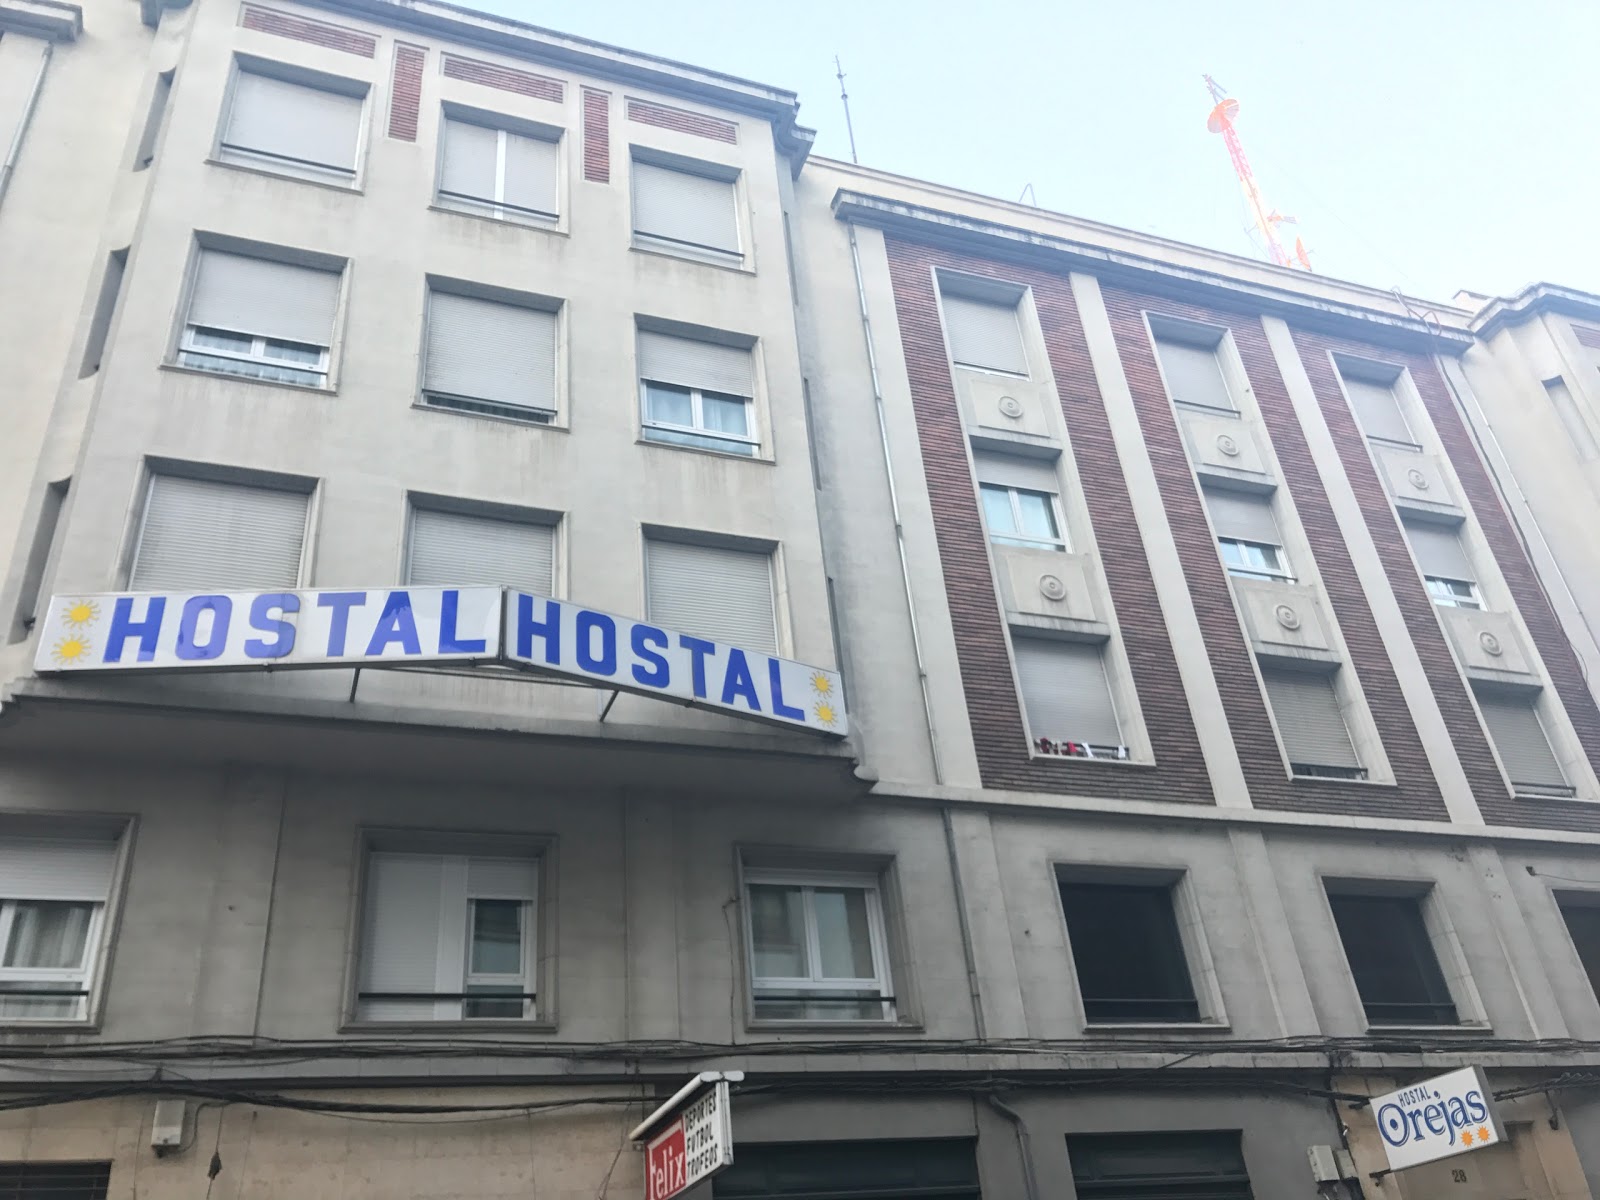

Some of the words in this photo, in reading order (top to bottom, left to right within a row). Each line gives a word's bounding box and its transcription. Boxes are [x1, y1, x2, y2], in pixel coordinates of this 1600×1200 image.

[103, 590, 487, 663] HOSTAL
[517, 594, 806, 721] HOSTAL
[685, 1091, 717, 1133] DEPORTES
[1398, 1085, 1431, 1107] HOSTAL
[1377, 1090, 1488, 1147] Orejas
[687, 1122, 713, 1155] FUTBOL
[687, 1143, 718, 1179] TROFEOS
[1452, 1169, 1467, 1183] 28
